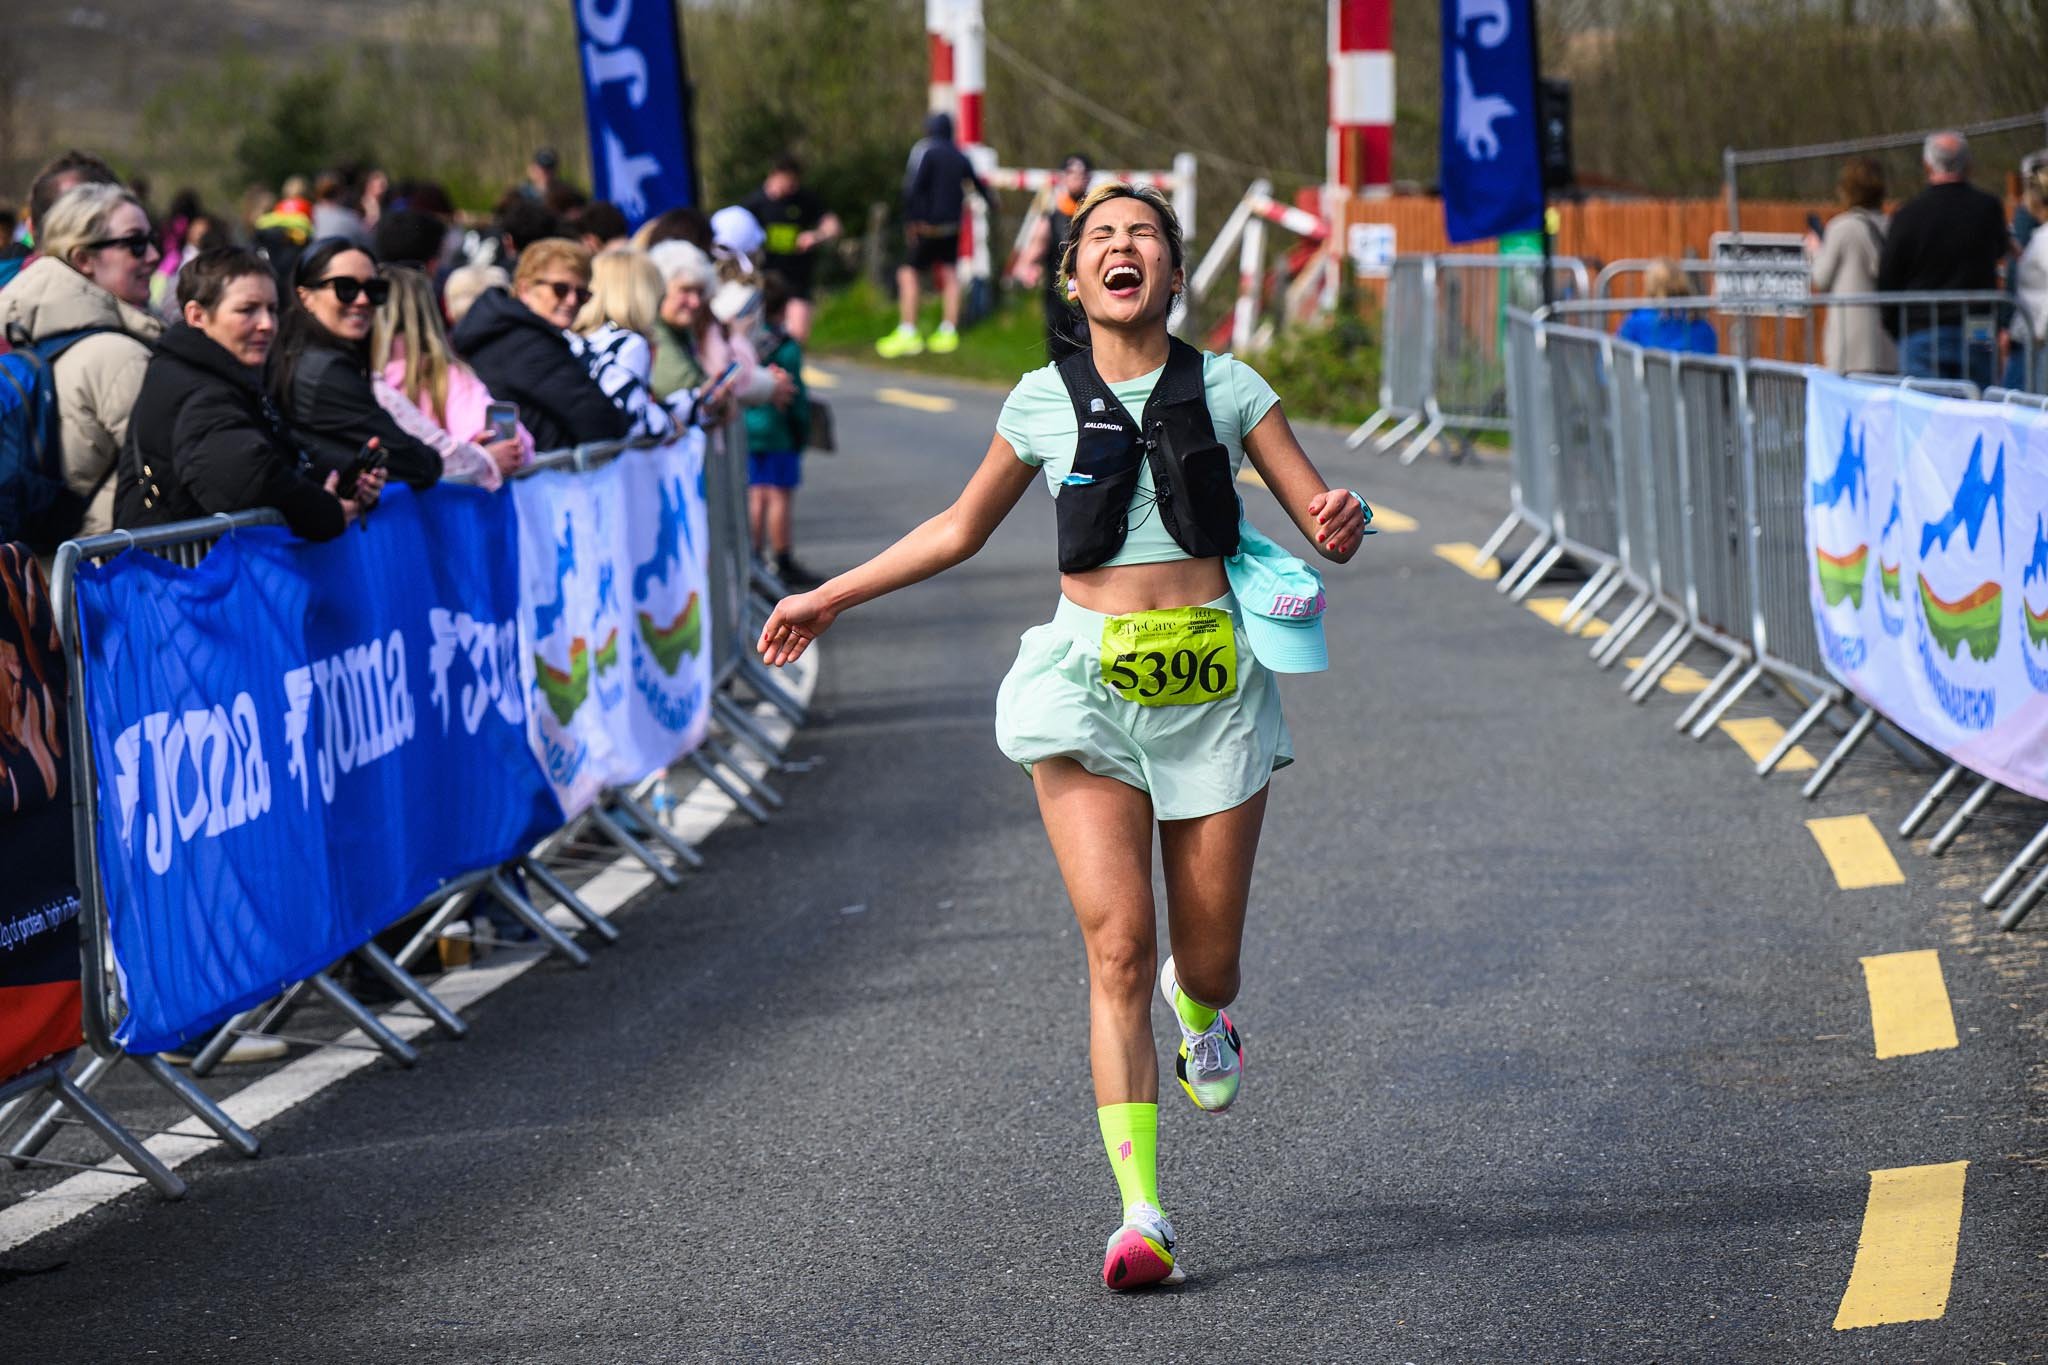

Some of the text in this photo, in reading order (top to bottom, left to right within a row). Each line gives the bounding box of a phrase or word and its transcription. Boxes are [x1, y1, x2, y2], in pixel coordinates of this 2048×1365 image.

[1083, 422, 1123, 432] SALOMON
[1126, 620, 1177, 635] DeCare
[1110, 645, 1228, 698] 5396
